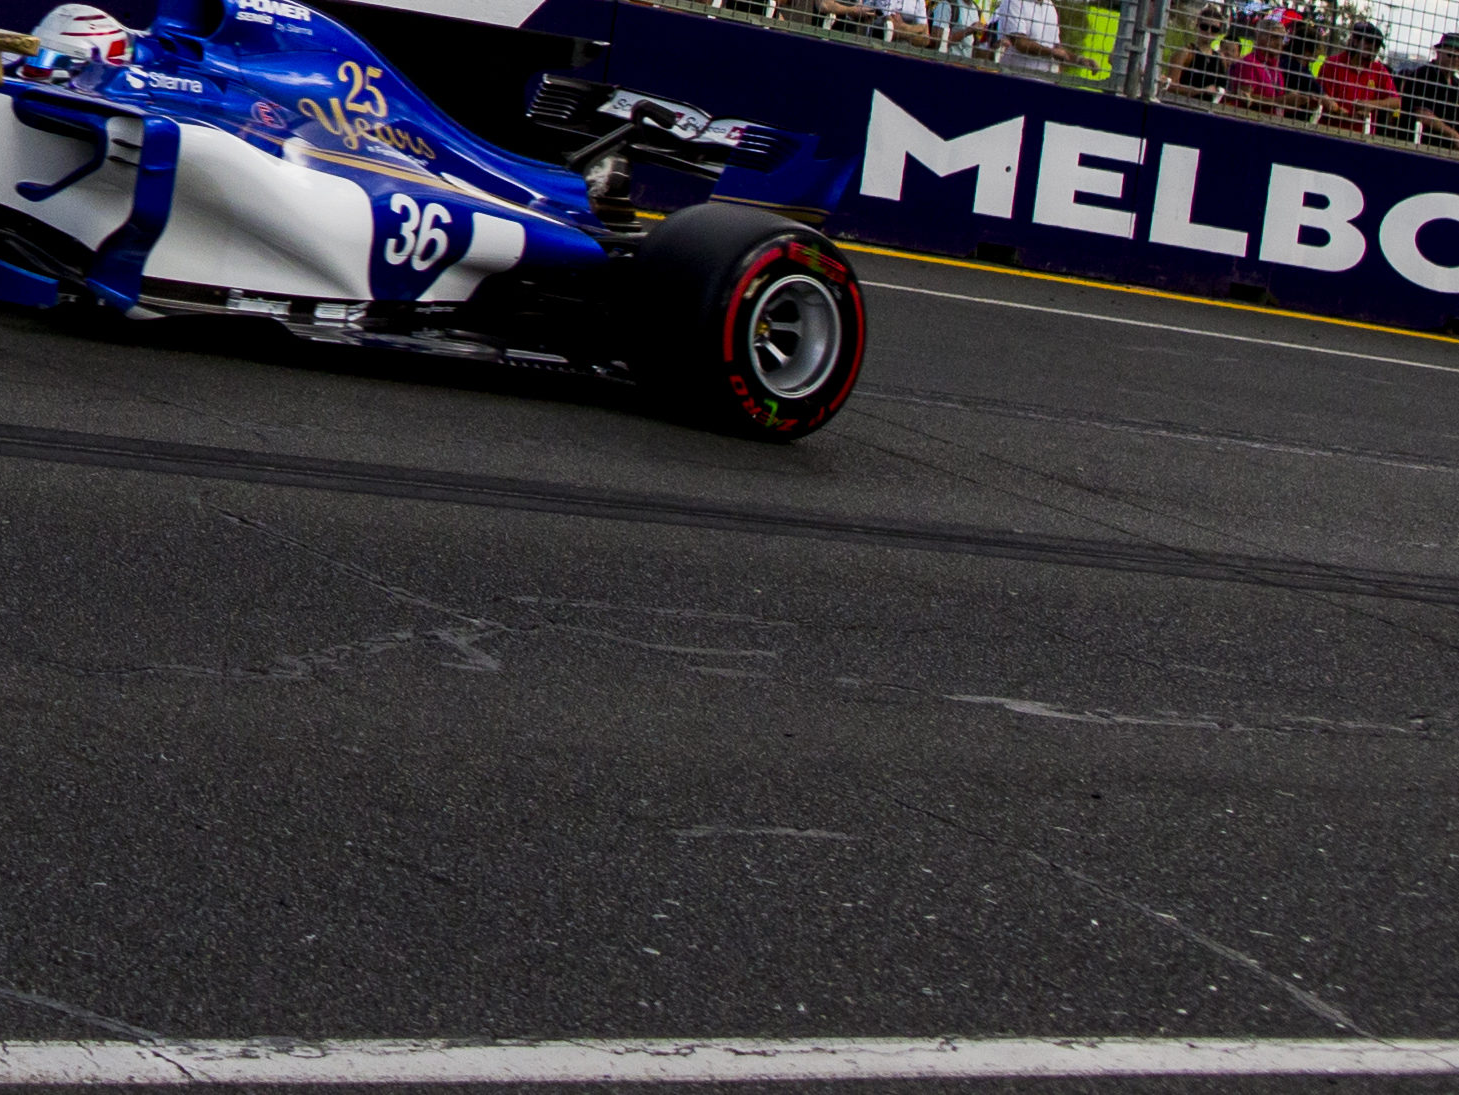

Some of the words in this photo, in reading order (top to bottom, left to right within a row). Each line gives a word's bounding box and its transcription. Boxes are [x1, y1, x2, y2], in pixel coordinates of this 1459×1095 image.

[337, 60, 388, 118] 25
[298, 98, 436, 160] Years
[860, 89, 1459, 294] MELBO
[384, 193, 453, 272] 36
